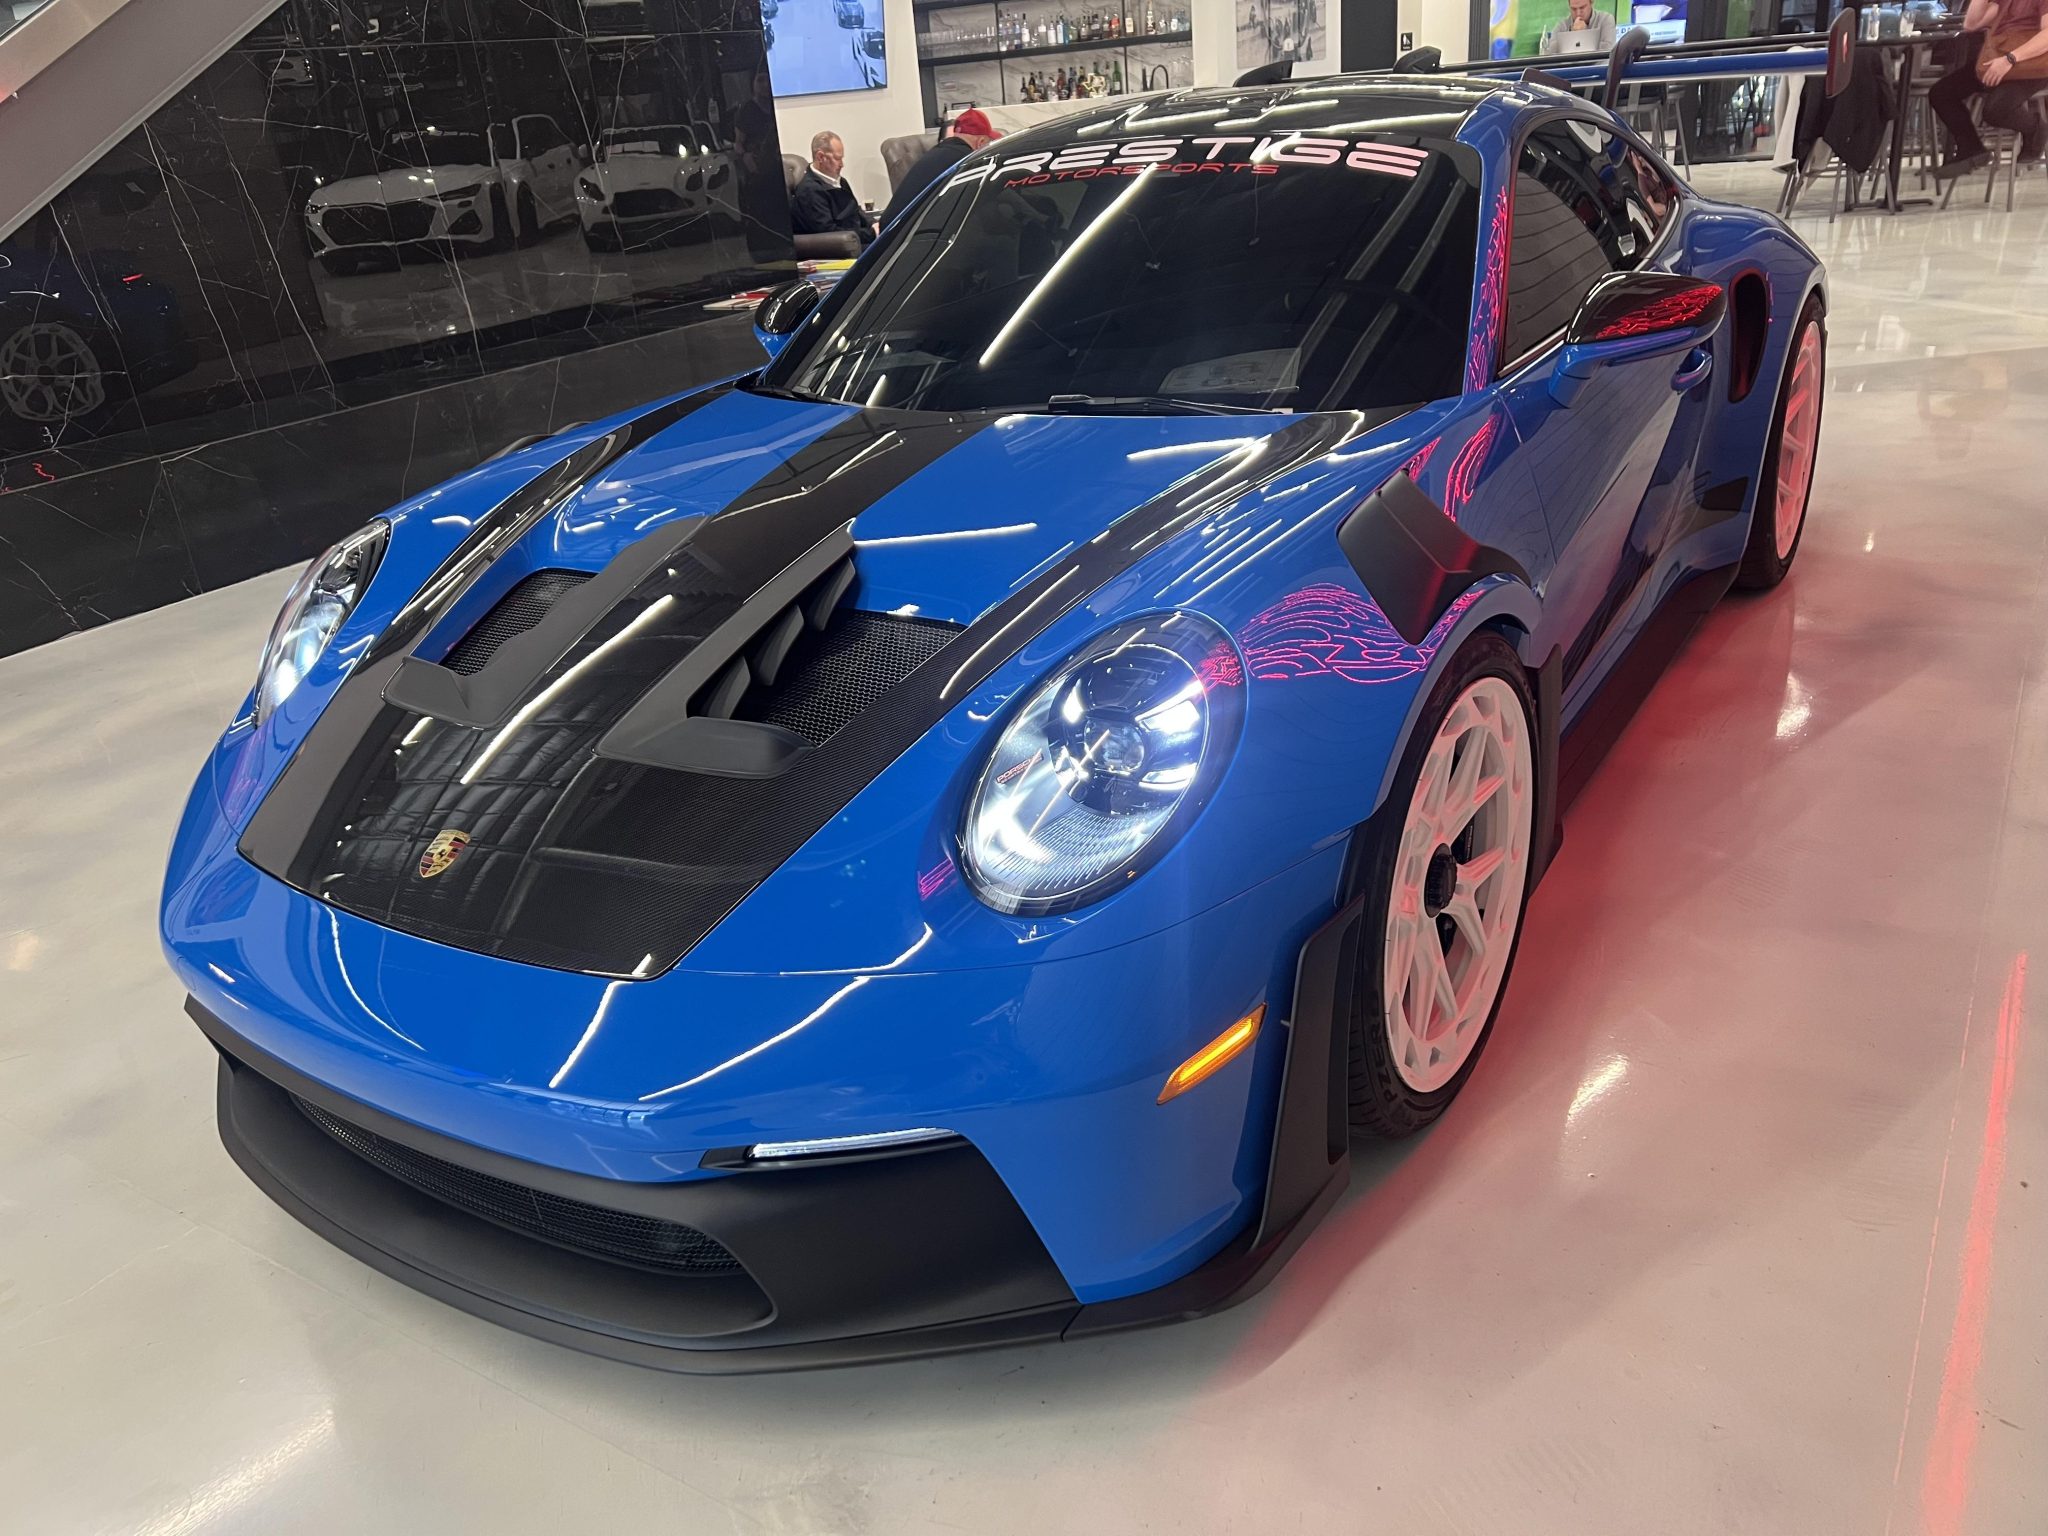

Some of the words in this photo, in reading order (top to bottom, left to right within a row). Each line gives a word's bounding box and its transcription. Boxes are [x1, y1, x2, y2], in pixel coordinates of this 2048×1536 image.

[939, 136, 1428, 197] PRESTIGE
[1004, 162, 1279, 188] MOTORSPORTS
[997, 754, 1042, 782] PORSC
